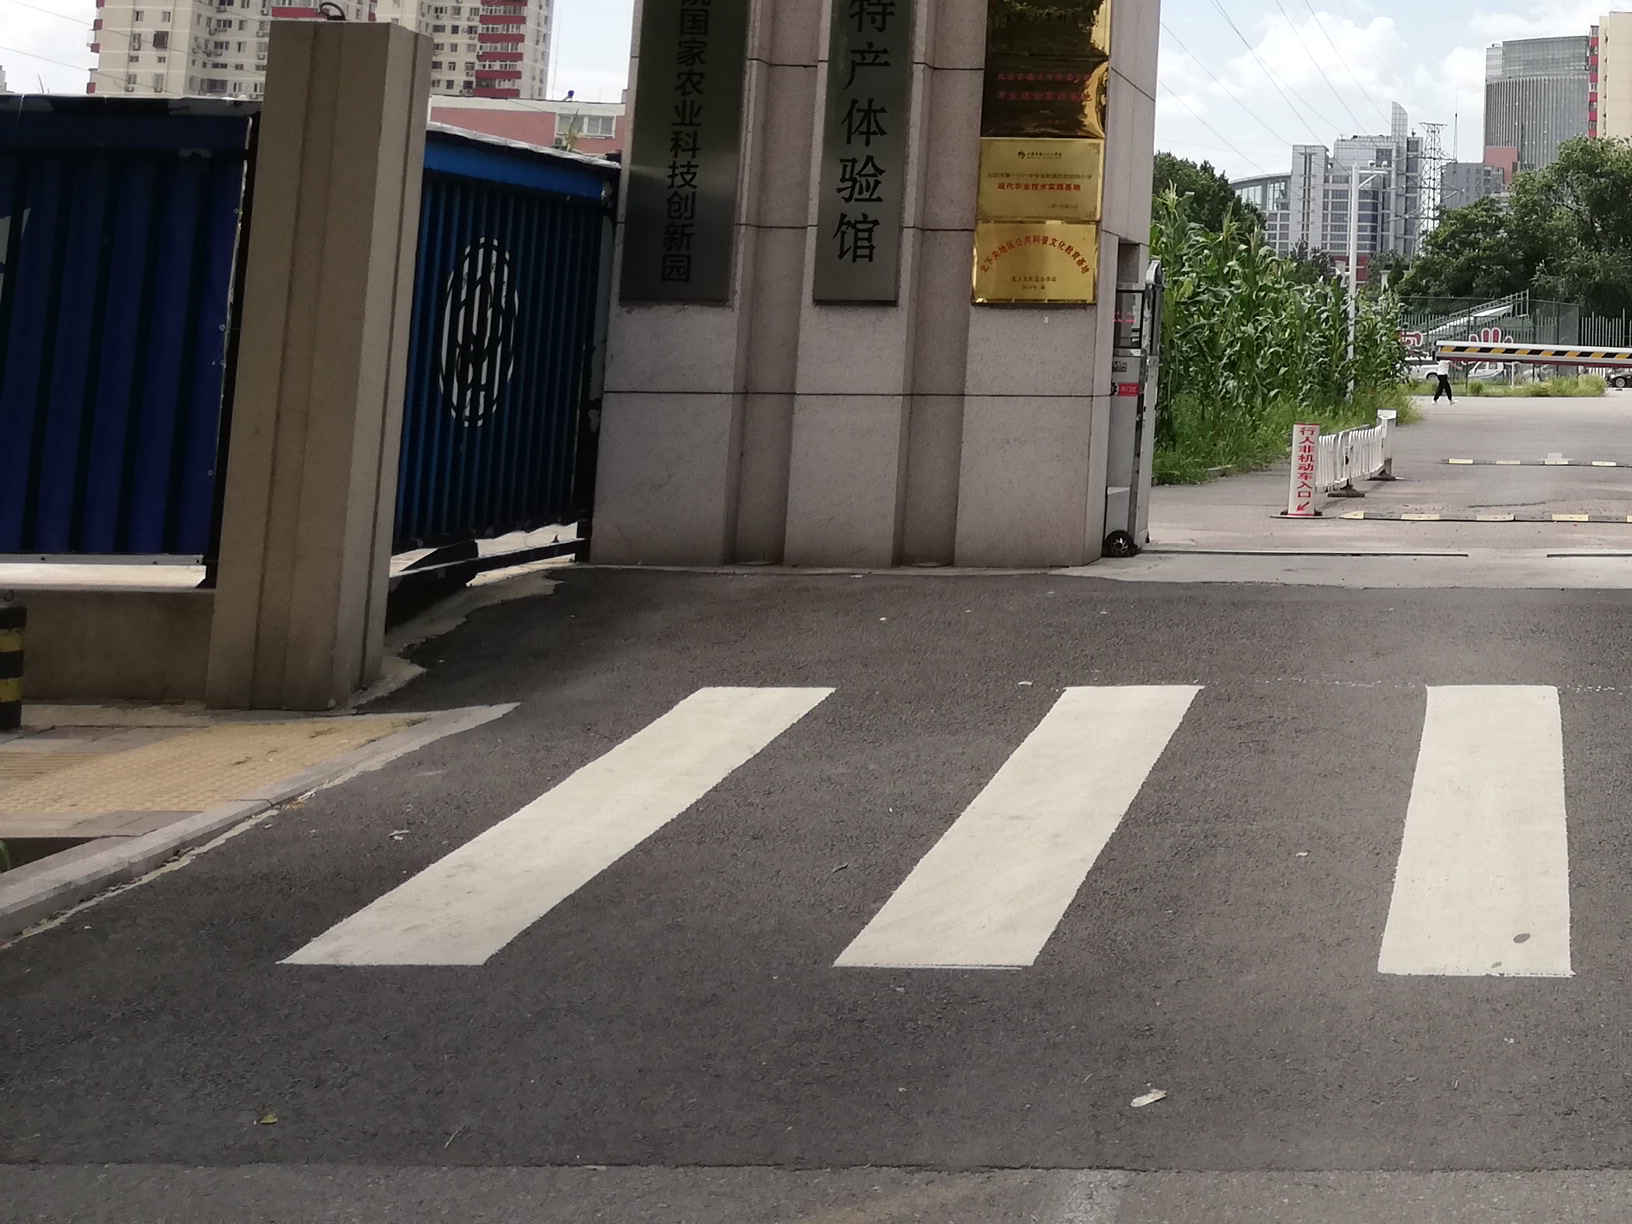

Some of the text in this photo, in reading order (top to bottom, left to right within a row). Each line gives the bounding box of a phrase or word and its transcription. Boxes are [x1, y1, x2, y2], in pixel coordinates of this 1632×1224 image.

[1297, 427, 1316, 498] 行人非机动车入口
